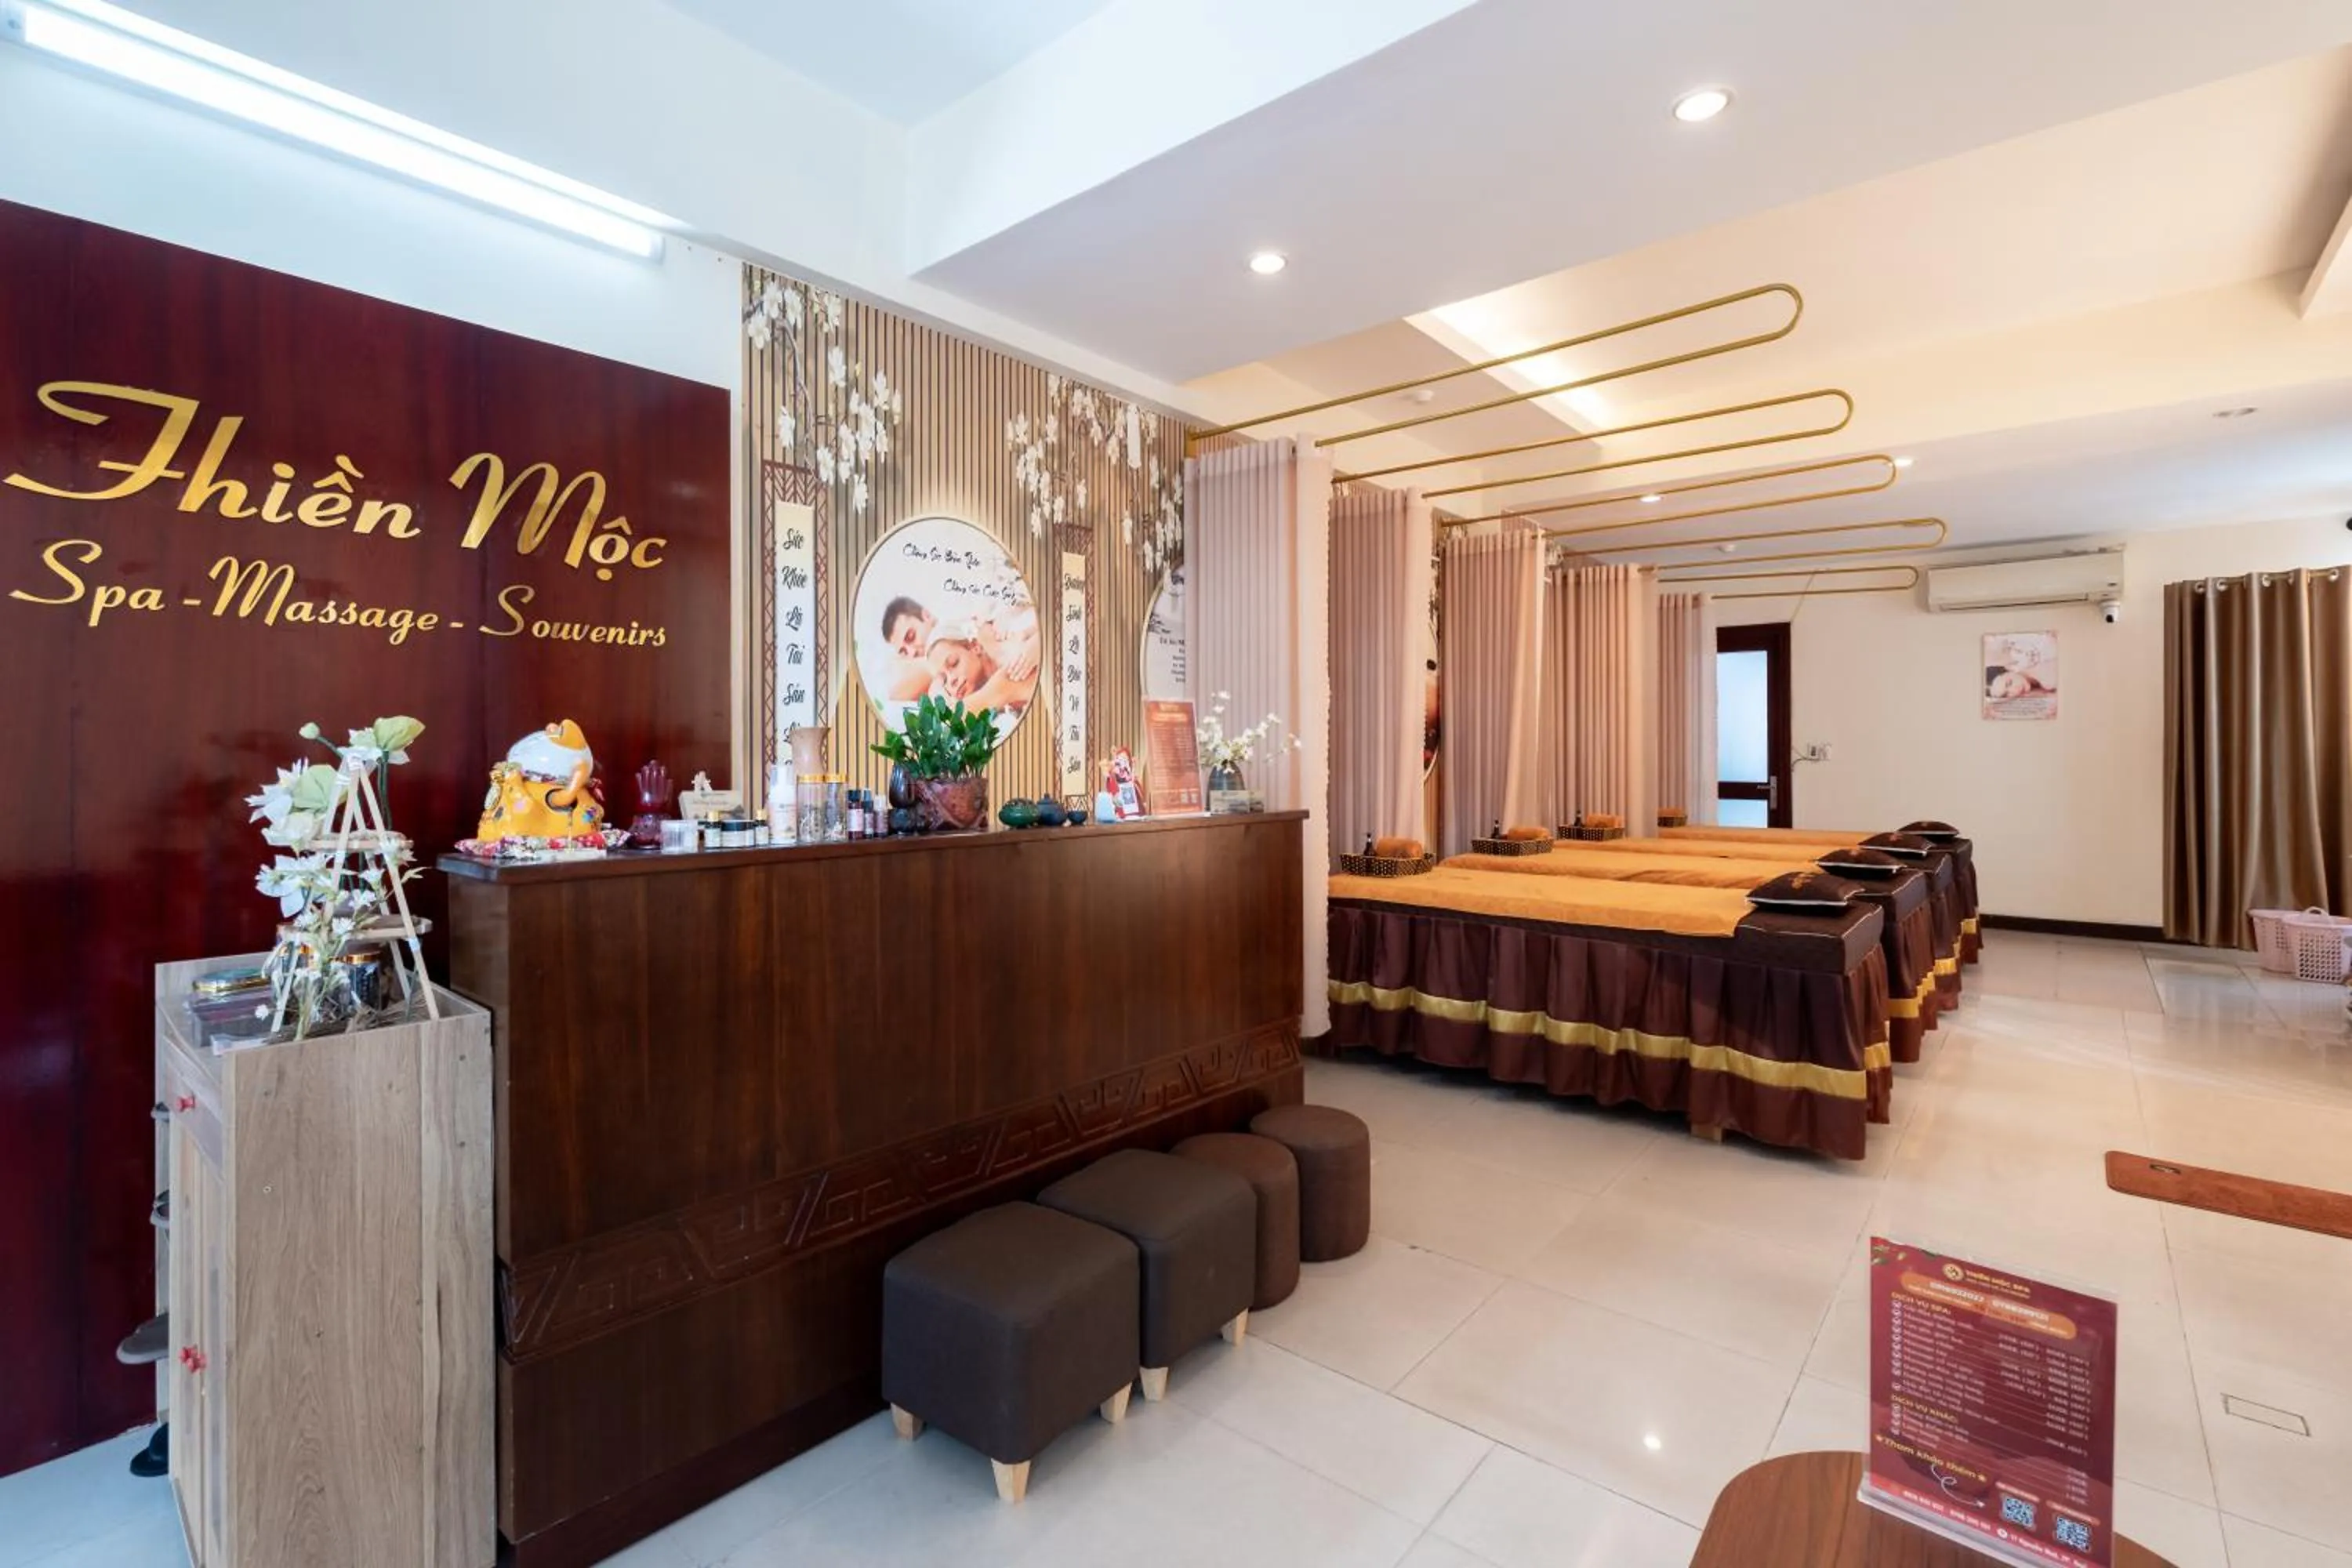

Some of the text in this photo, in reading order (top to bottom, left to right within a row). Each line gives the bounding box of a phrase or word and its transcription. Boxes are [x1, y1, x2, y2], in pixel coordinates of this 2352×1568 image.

[2, 381, 667, 581] Thiền Mộc
[8, 539, 165, 627] Spa
[208, 556, 438, 645] Massage
[479, 584, 666, 647] Souvenirs
